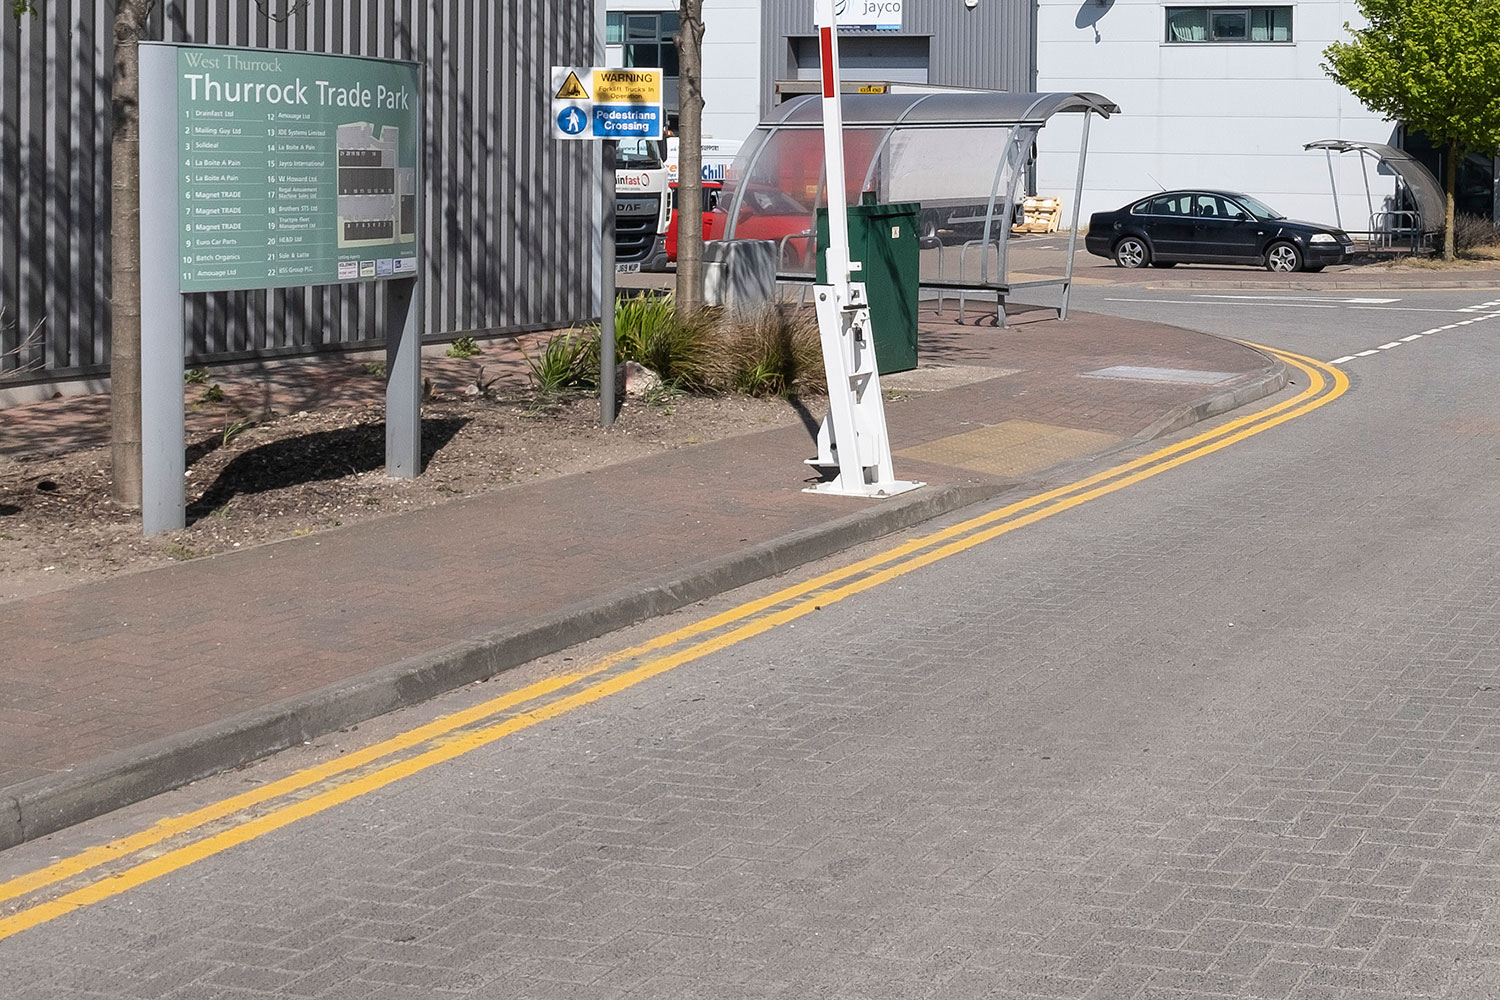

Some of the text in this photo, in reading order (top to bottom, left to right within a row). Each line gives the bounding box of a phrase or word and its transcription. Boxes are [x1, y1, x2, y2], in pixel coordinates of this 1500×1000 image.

[862, 0, 901, 18] jayco
[184, 53, 282, 72] West Thurrock
[601, 73, 653, 82] WARNING
[184, 73, 409, 110] Thurrock Trade Park
[267, 113, 275, 121] 12
[596, 110, 656, 120] Pedestrians
[184, 126, 190, 134] 2
[604, 122, 649, 131] Crossing
[267, 129, 275, 137] 13
[185, 143, 190, 151] 3
[267, 144, 275, 152] 14
[267, 160, 275, 168] 15
[185, 175, 191, 183] 5
[267, 175, 275, 183] 16
[185, 191, 191, 199] 6
[195, 191, 220, 199] Magnet
[195, 207, 220, 215] Magnet
[268, 206, 276, 214] 18
[268, 222, 276, 230] 19
[185, 240, 191, 248] 9
[267, 237, 276, 245] 20
[183, 256, 192, 264] 10
[183, 272, 191, 280] 11
